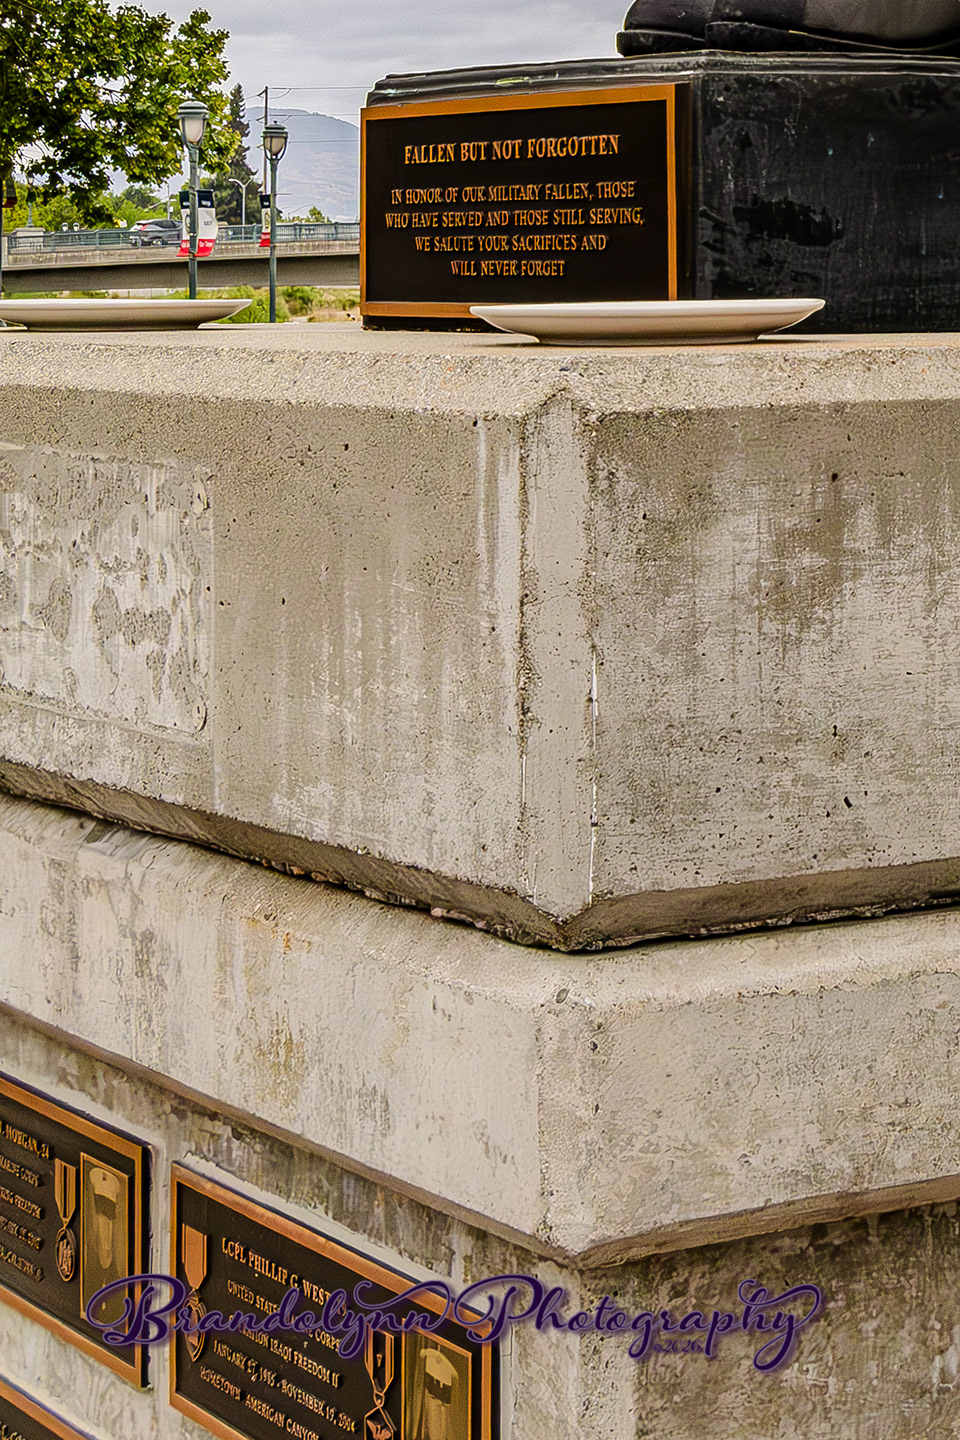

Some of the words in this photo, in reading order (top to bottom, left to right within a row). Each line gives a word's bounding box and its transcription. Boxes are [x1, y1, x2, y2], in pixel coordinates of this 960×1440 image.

[404, 143, 456, 165] FALLEN
[460, 141, 487, 162] BUT
[492, 139, 522, 160] NOT
[527, 134, 621, 159] FORGOTTEN
[391, 188, 403, 205] IN
[405, 187, 444, 205] HONOR
[445, 186, 460, 203] OF
[462, 185, 487, 203] OUR
[488, 183, 544, 203] MILITARY
[545, 181, 594, 202] FALLEN,
[596, 180, 637, 199] THOSE
[385, 212, 409, 229] WHO
[412, 211, 439, 228] HAVE
[442, 210, 484, 228] SERVED
[486, 210, 510, 227] AND
[512, 209, 549, 226] THOSE
[553, 208, 585, 226] STILL
[415, 236, 431, 252] WE
[434, 236, 475, 252] SALUTE
[478, 235, 510, 252] YOUR
[512, 235, 578, 251] SACRIFICES
[581, 234, 609, 251] AND
[451, 260, 477, 276] WILL
[480, 260, 518, 276] NEVER
[521, 260, 566, 276] FORGET
[222, 1237, 246, 1264] LCPL
[248, 1250, 288, 1285] PHILLIP
[227, 1279, 254, 1304] UNITED
[255, 1295, 280, 1315] STATE
[293, 1351, 330, 1384] FREEDOM
[245, 1394, 285, 1428] AMERICAN
